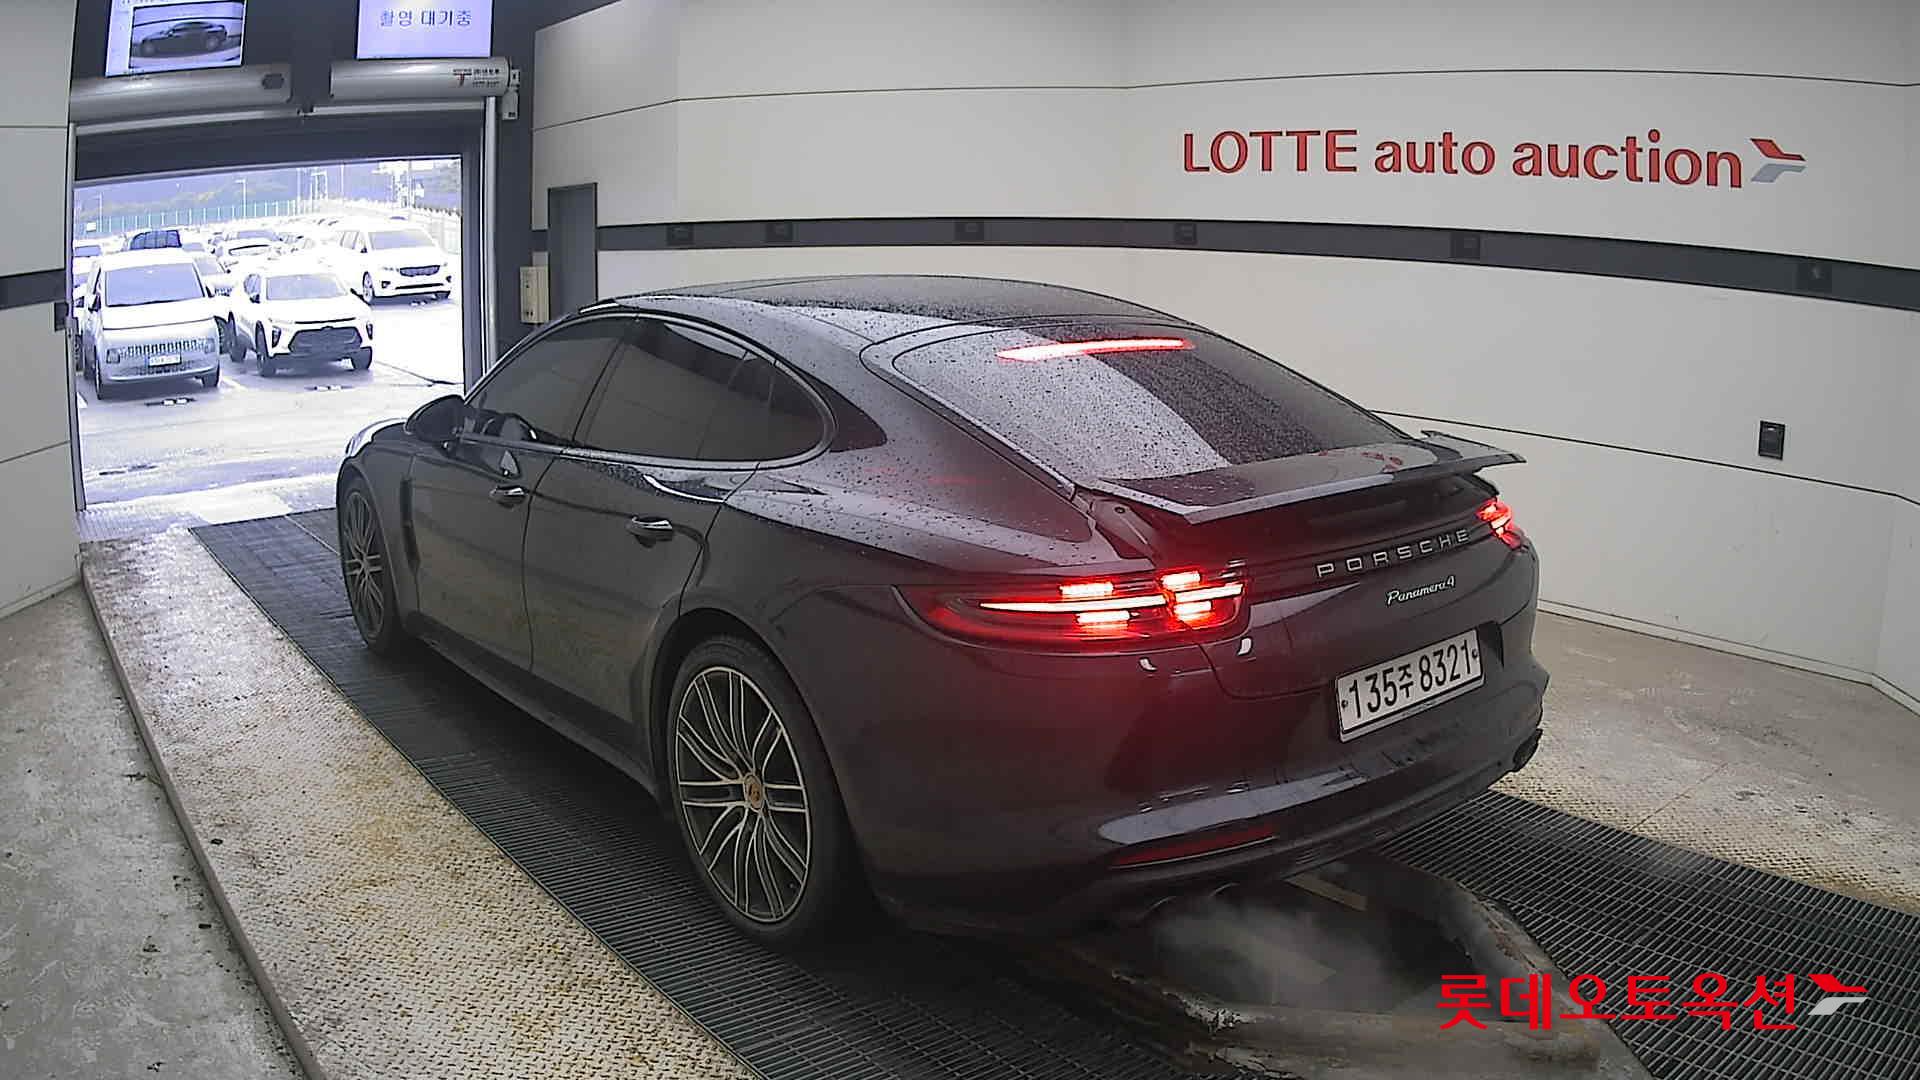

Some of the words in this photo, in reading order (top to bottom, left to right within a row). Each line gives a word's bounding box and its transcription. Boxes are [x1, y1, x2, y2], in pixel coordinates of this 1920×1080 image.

[1184, 129, 1358, 173] LOTTE
[1374, 131, 1496, 175] auto
[1512, 129, 1744, 189] auction
[1316, 529, 1470, 577] PORSCHE
